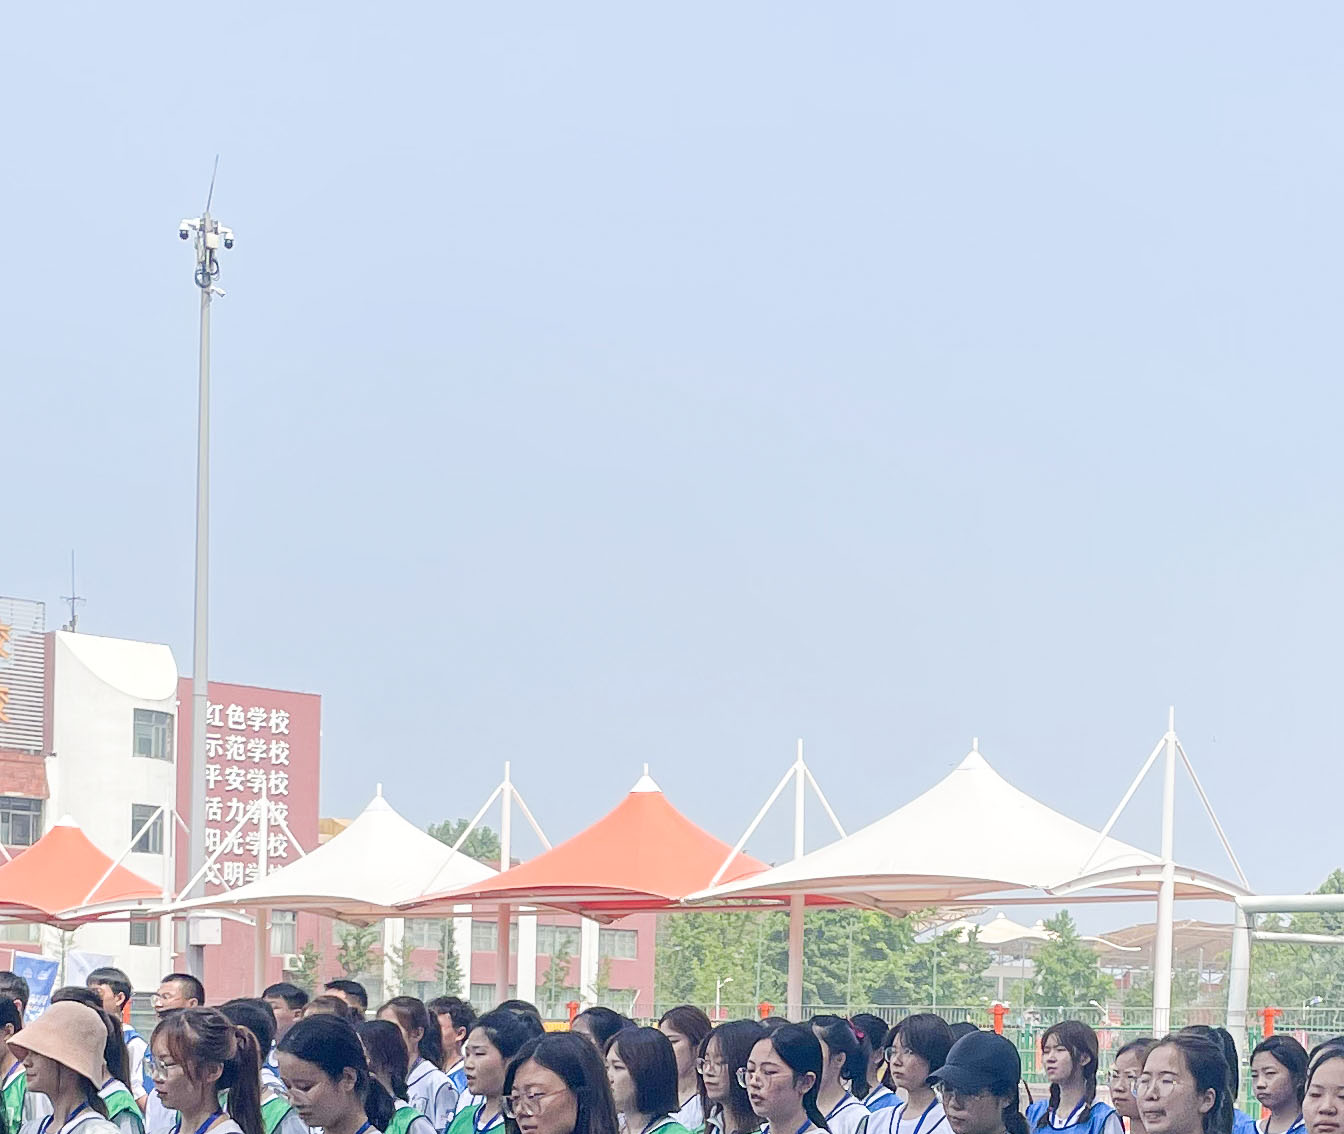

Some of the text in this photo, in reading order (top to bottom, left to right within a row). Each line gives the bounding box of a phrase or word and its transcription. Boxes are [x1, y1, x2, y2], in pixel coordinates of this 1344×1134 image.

[207, 700, 291, 735] 红色学校
[206, 733, 290, 766] 示范学校
[206, 764, 289, 796] 平安学校
